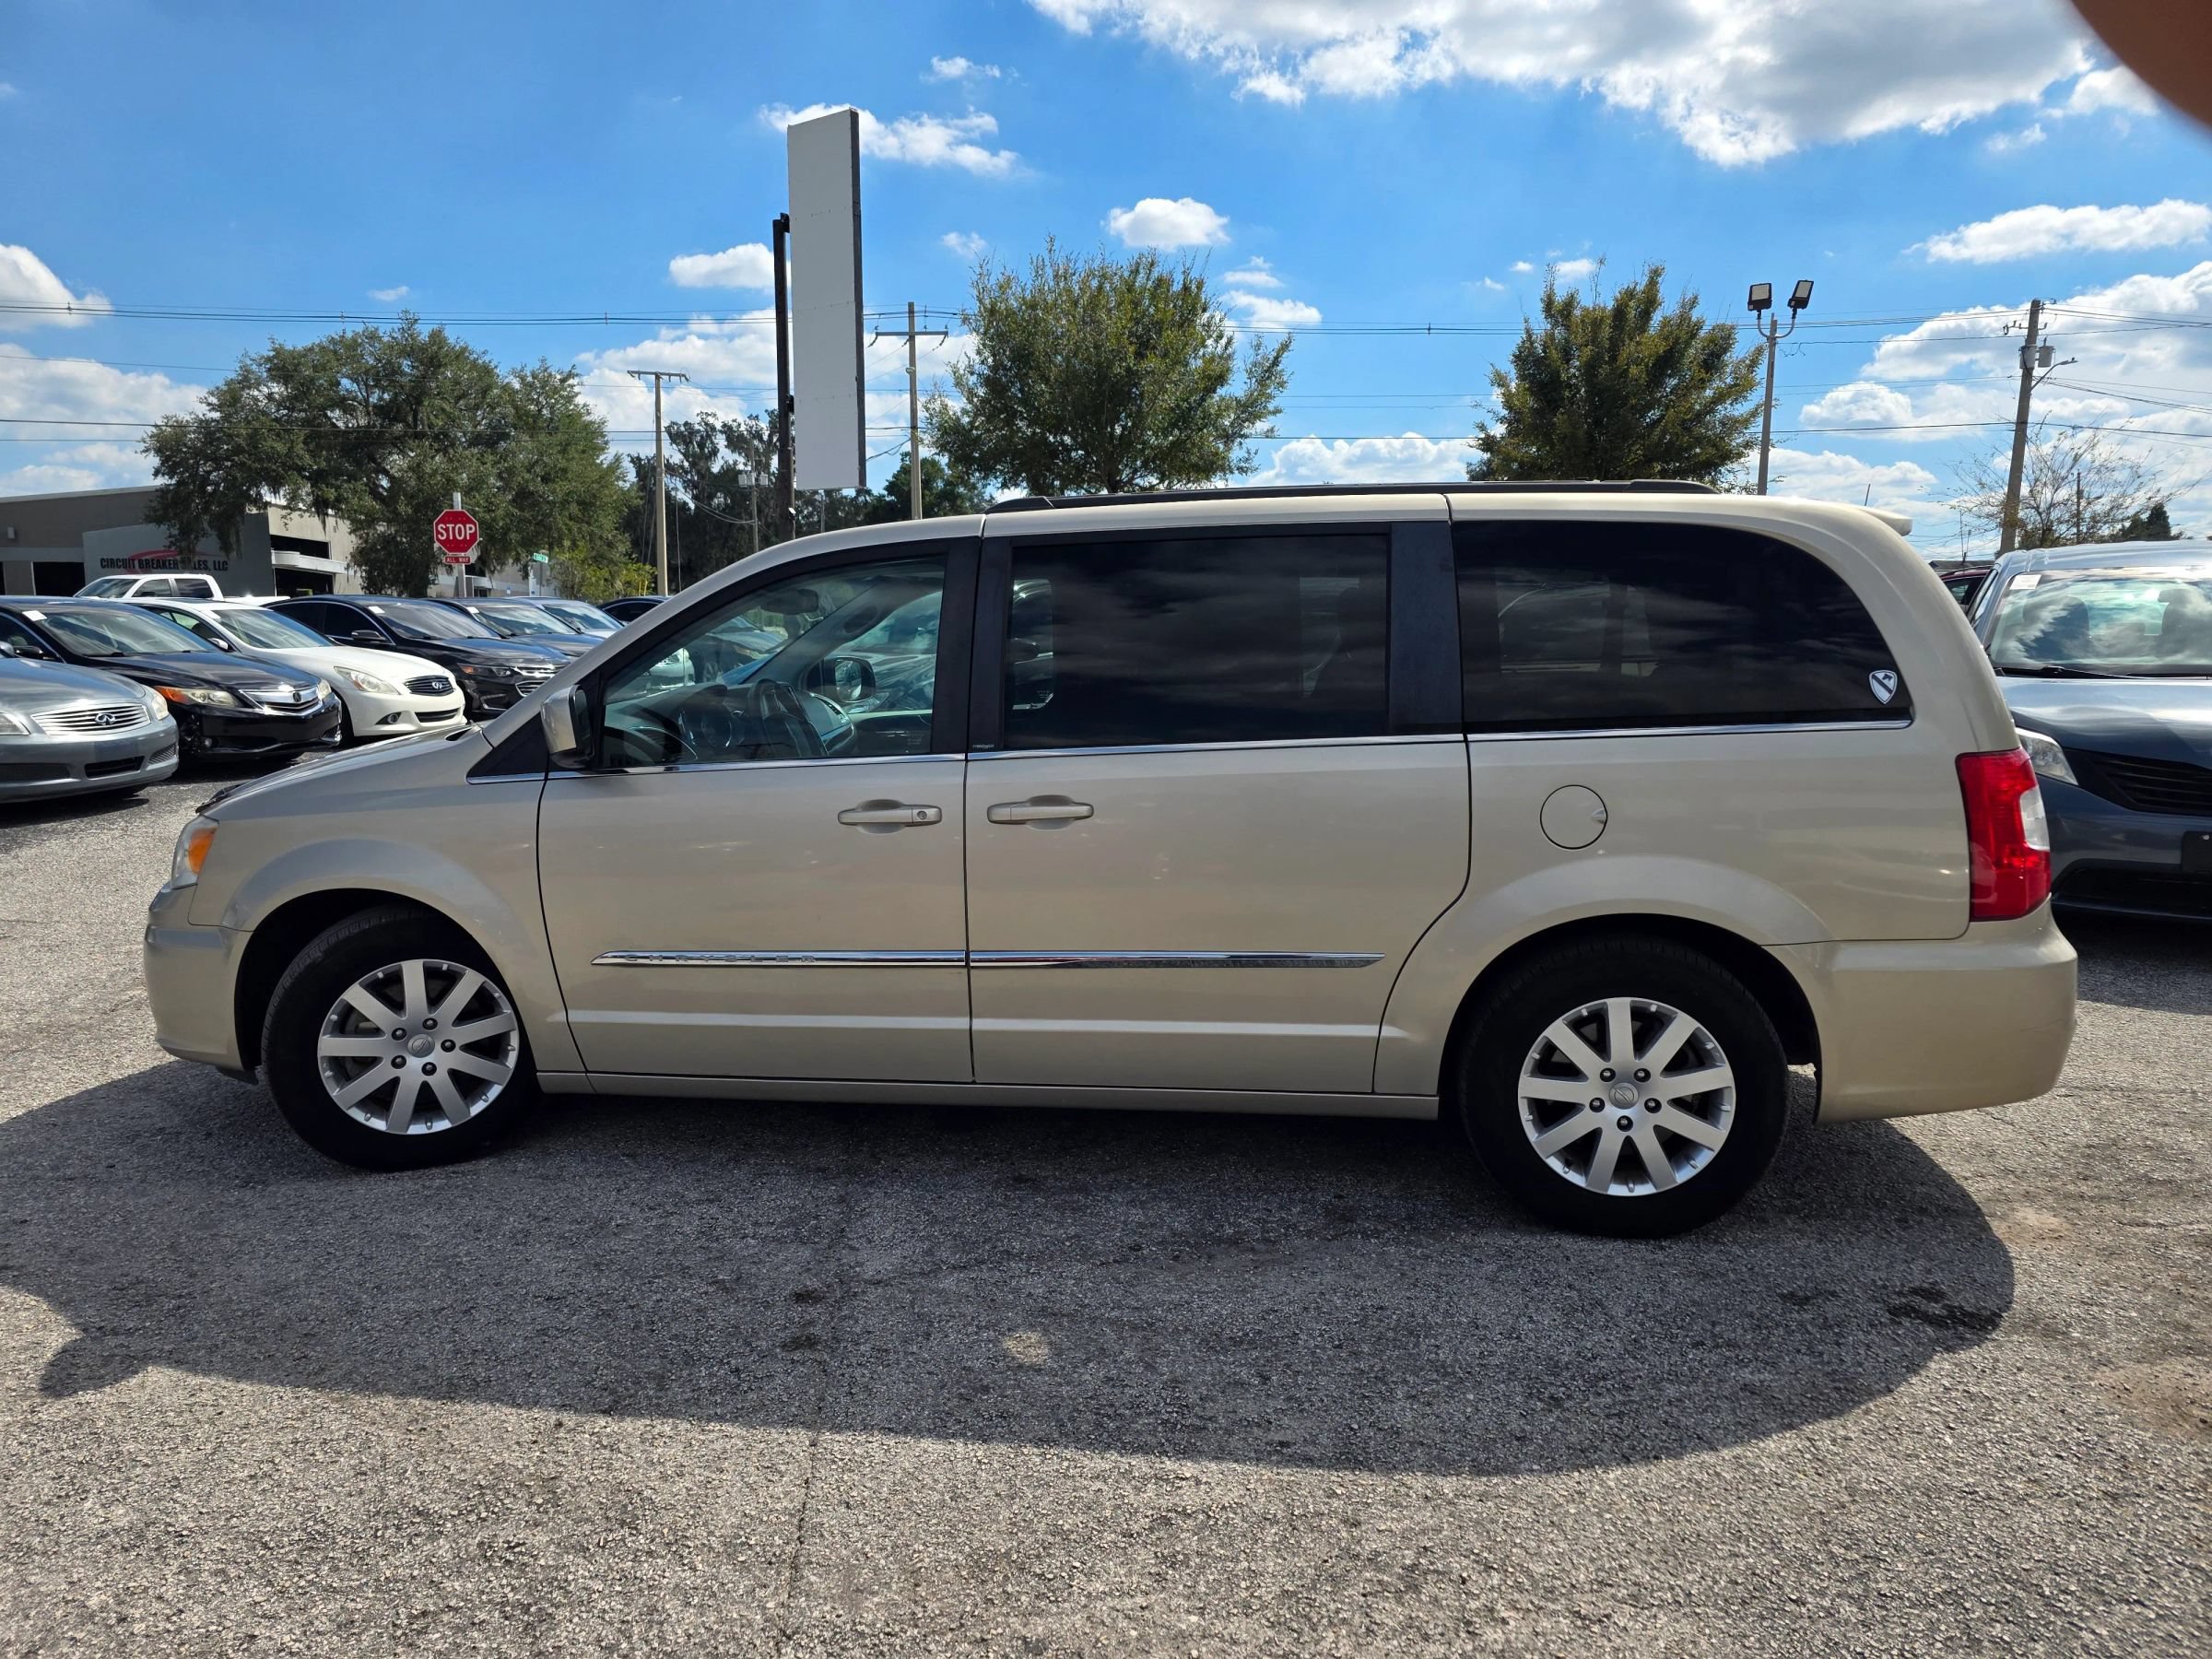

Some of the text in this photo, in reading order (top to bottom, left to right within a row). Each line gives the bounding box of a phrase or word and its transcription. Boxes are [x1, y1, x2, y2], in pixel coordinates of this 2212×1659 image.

[437, 524, 476, 540] STOP
[100, 558, 229, 572] CIRCUIT BREAKER SLES, LLC
[625, 954, 815, 962] CHRYSLER
